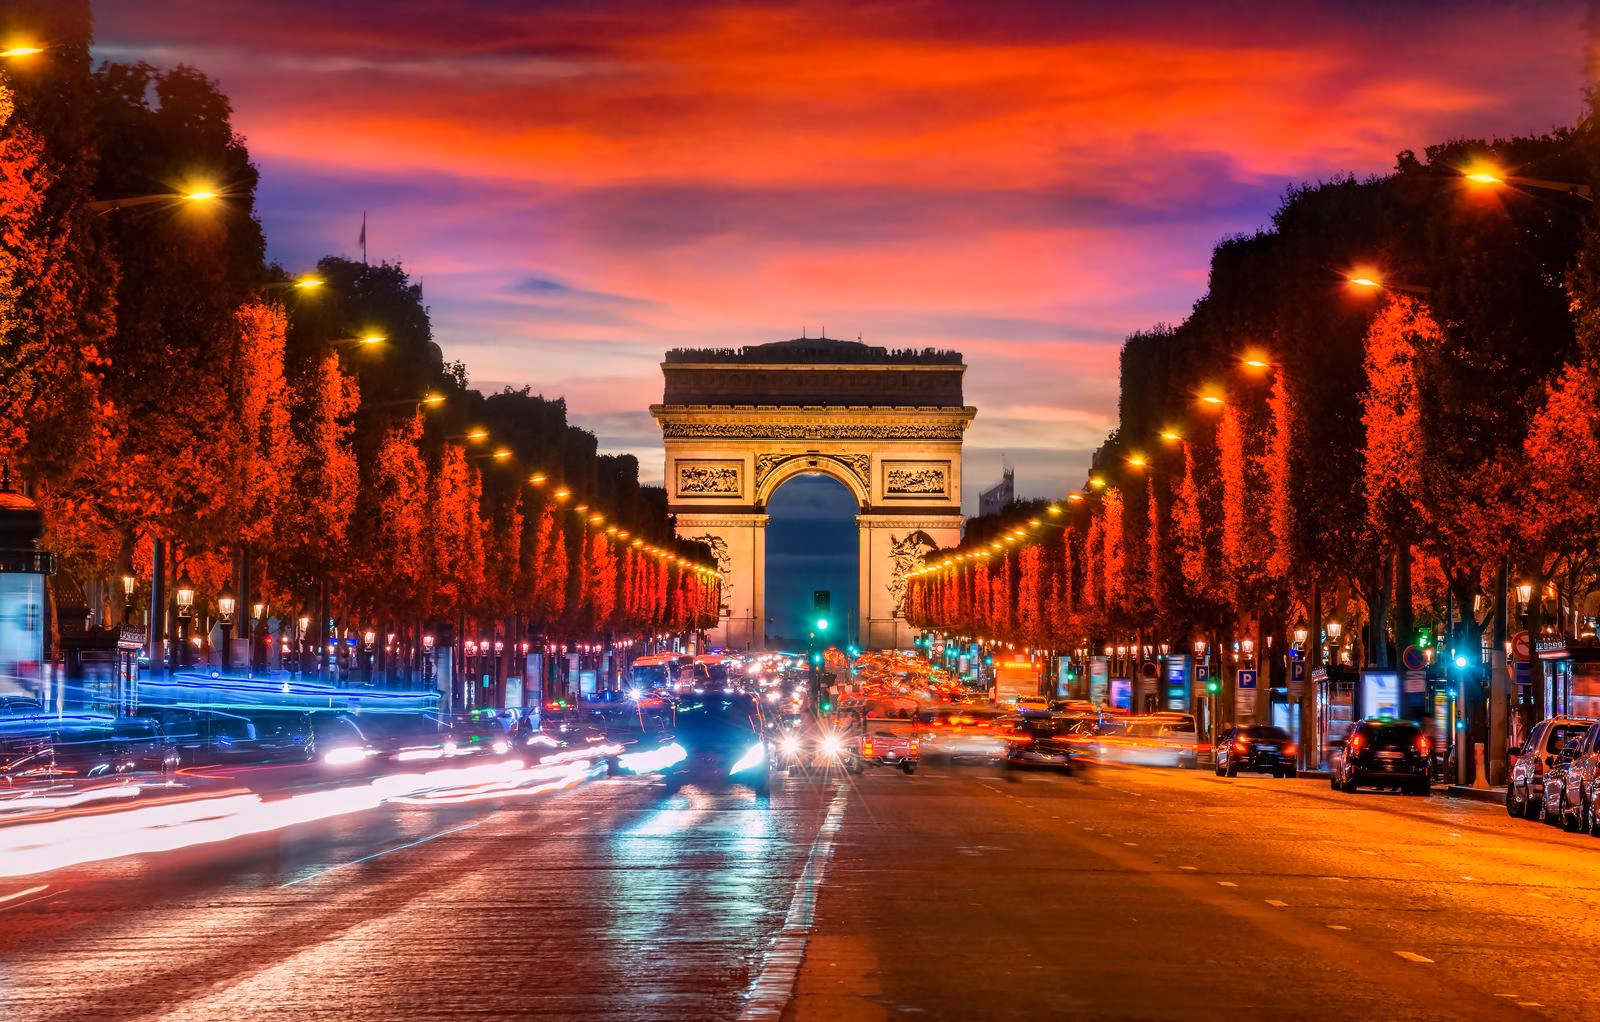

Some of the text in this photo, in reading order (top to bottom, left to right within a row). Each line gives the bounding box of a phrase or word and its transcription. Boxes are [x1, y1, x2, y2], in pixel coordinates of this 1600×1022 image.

[1198, 668, 1206, 679] P
[1295, 665, 1303, 678] P
[1243, 673, 1252, 686] P
